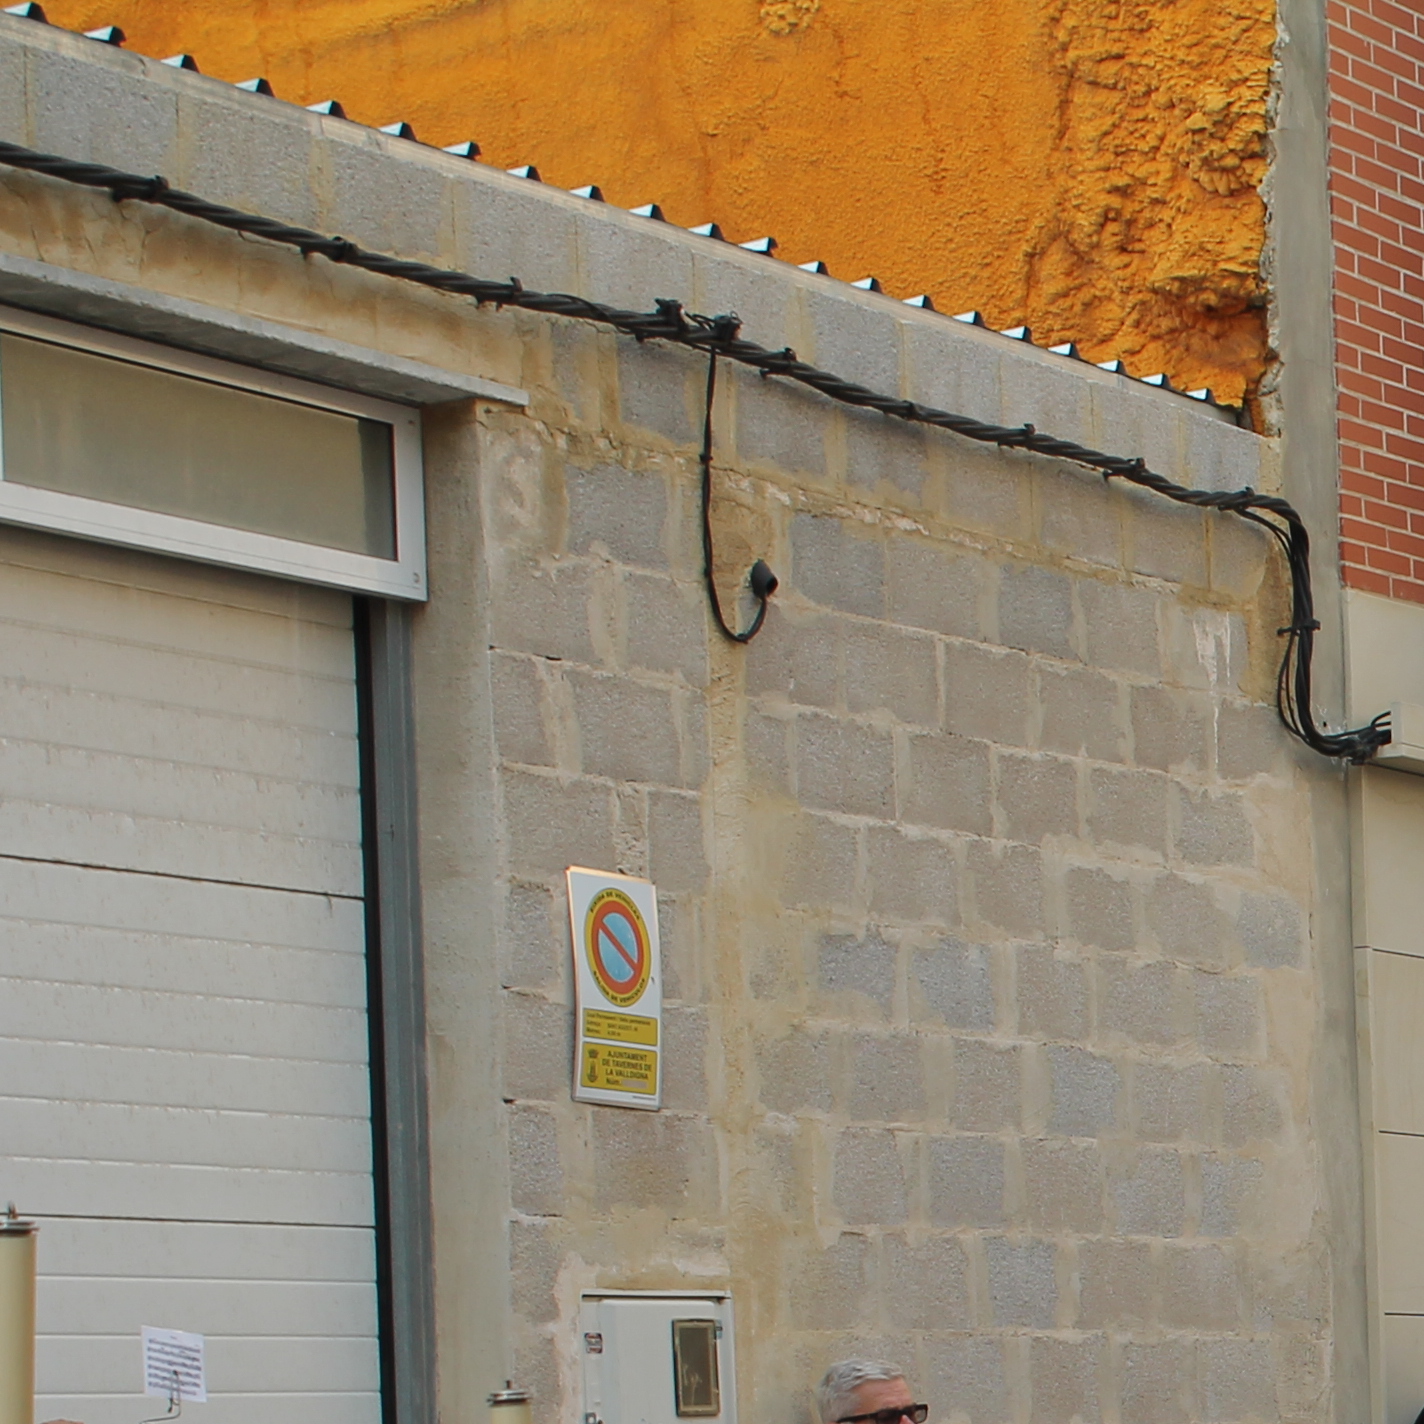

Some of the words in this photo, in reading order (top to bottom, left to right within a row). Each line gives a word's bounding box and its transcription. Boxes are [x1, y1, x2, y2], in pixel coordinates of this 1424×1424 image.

[608, 1051, 647, 1061] AJUNTAMENT
[612, 1060, 642, 1070] TAVERNES
[616, 1070, 648, 1079] VALLDIGNA
